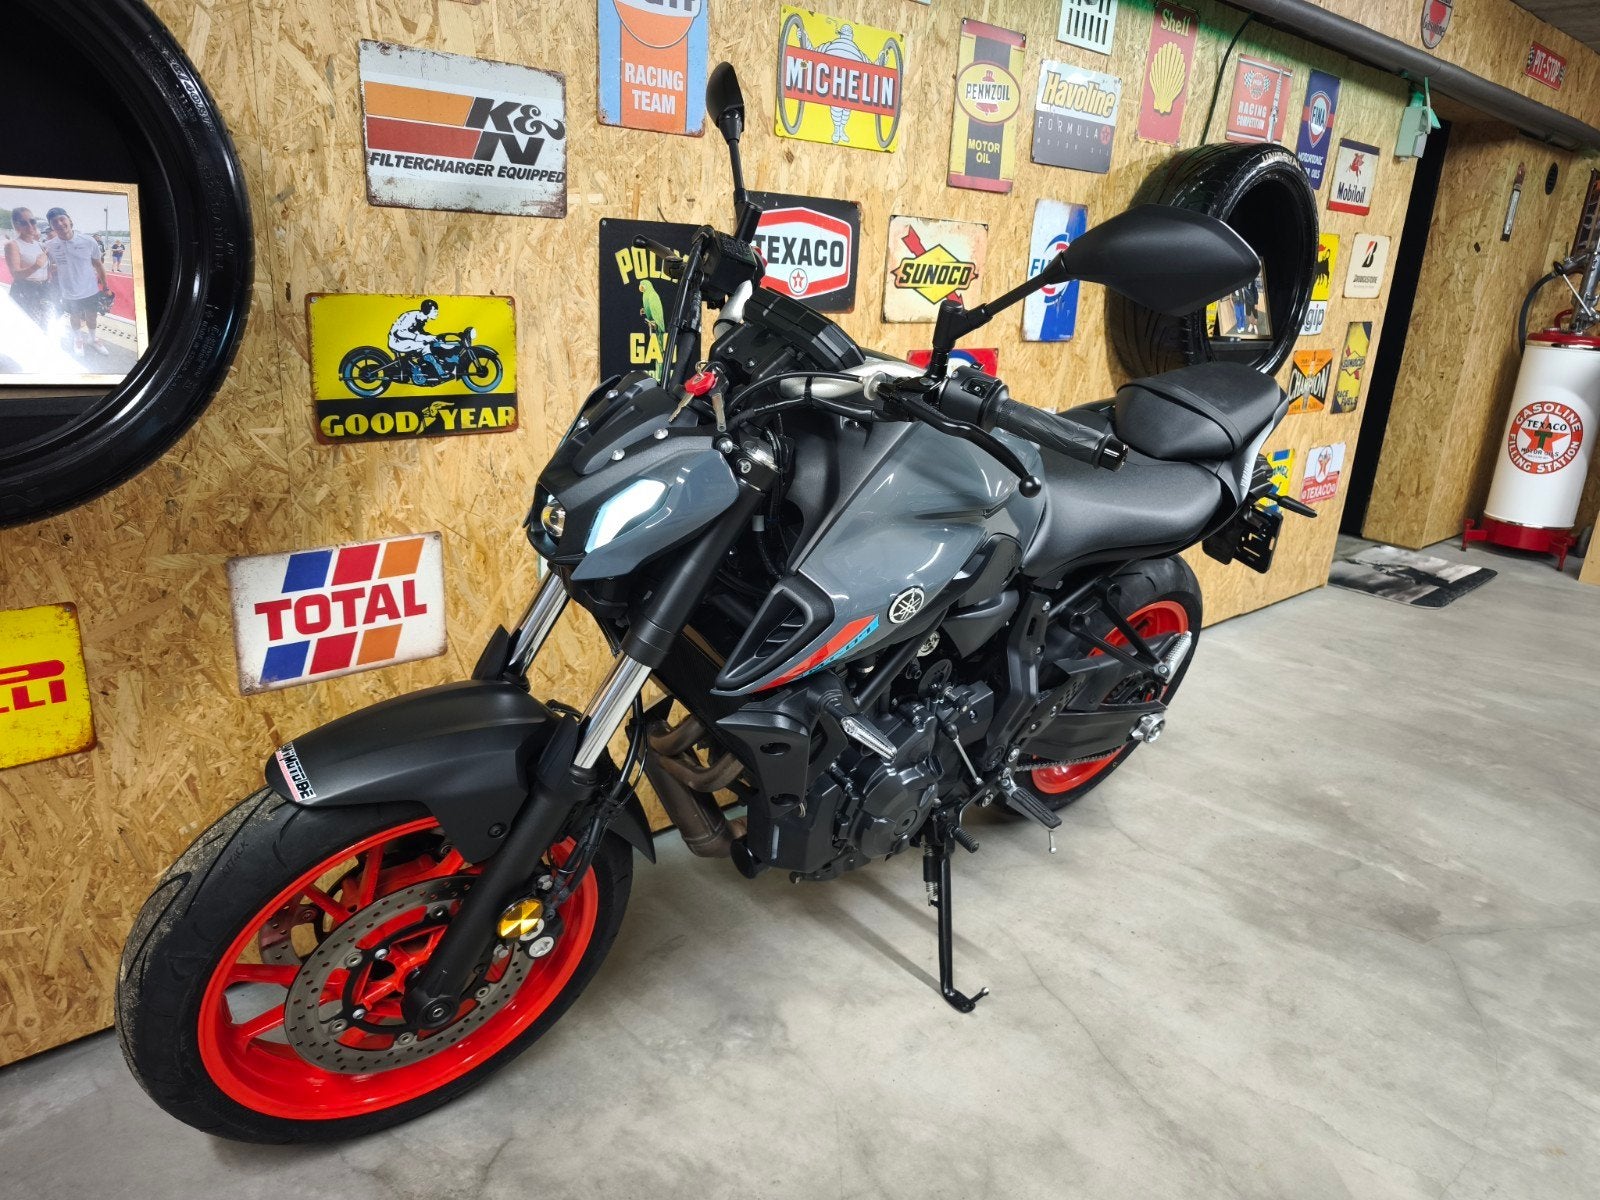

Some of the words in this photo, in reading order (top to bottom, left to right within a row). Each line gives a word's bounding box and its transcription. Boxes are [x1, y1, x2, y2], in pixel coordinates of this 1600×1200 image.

[1160, 9, 1191, 37] Shell
[624, 62, 684, 91] RACING
[1532, 49, 1562, 84] PIT-STOP
[785, 55, 896, 108] MICHELIN
[965, 82, 1010, 102] PENNZOIL
[1041, 70, 1116, 118] Havoline
[632, 89, 676, 115] TEAM
[1038, 116, 1098, 139] FORMULA
[1312, 106, 1326, 126] FINA
[968, 138, 1001, 154] MOTOR
[976, 151, 991, 165] OIL
[369, 152, 493, 178] FILTERCHARGER
[497, 166, 566, 184] EQUIPPED
[1337, 181, 1367, 203] Mobiloil
[753, 235, 846, 268] TEXACO
[615, 246, 690, 285] POL
[899, 262, 972, 286] SUNOCO
[1303, 304, 1325, 331] gip
[320, 411, 419, 437] GOOD
[438, 406, 517, 430] YEAR
[1516, 403, 1582, 433] GASOLINE
[1527, 420, 1567, 431] TEXACO
[1509, 433, 1532, 472] FILLING
[1536, 441, 1580, 473] STATION
[1521, 447, 1543, 455] MOTOR
[1306, 484, 1332, 499] TEXACO
[254, 578, 428, 641] TOTAL
